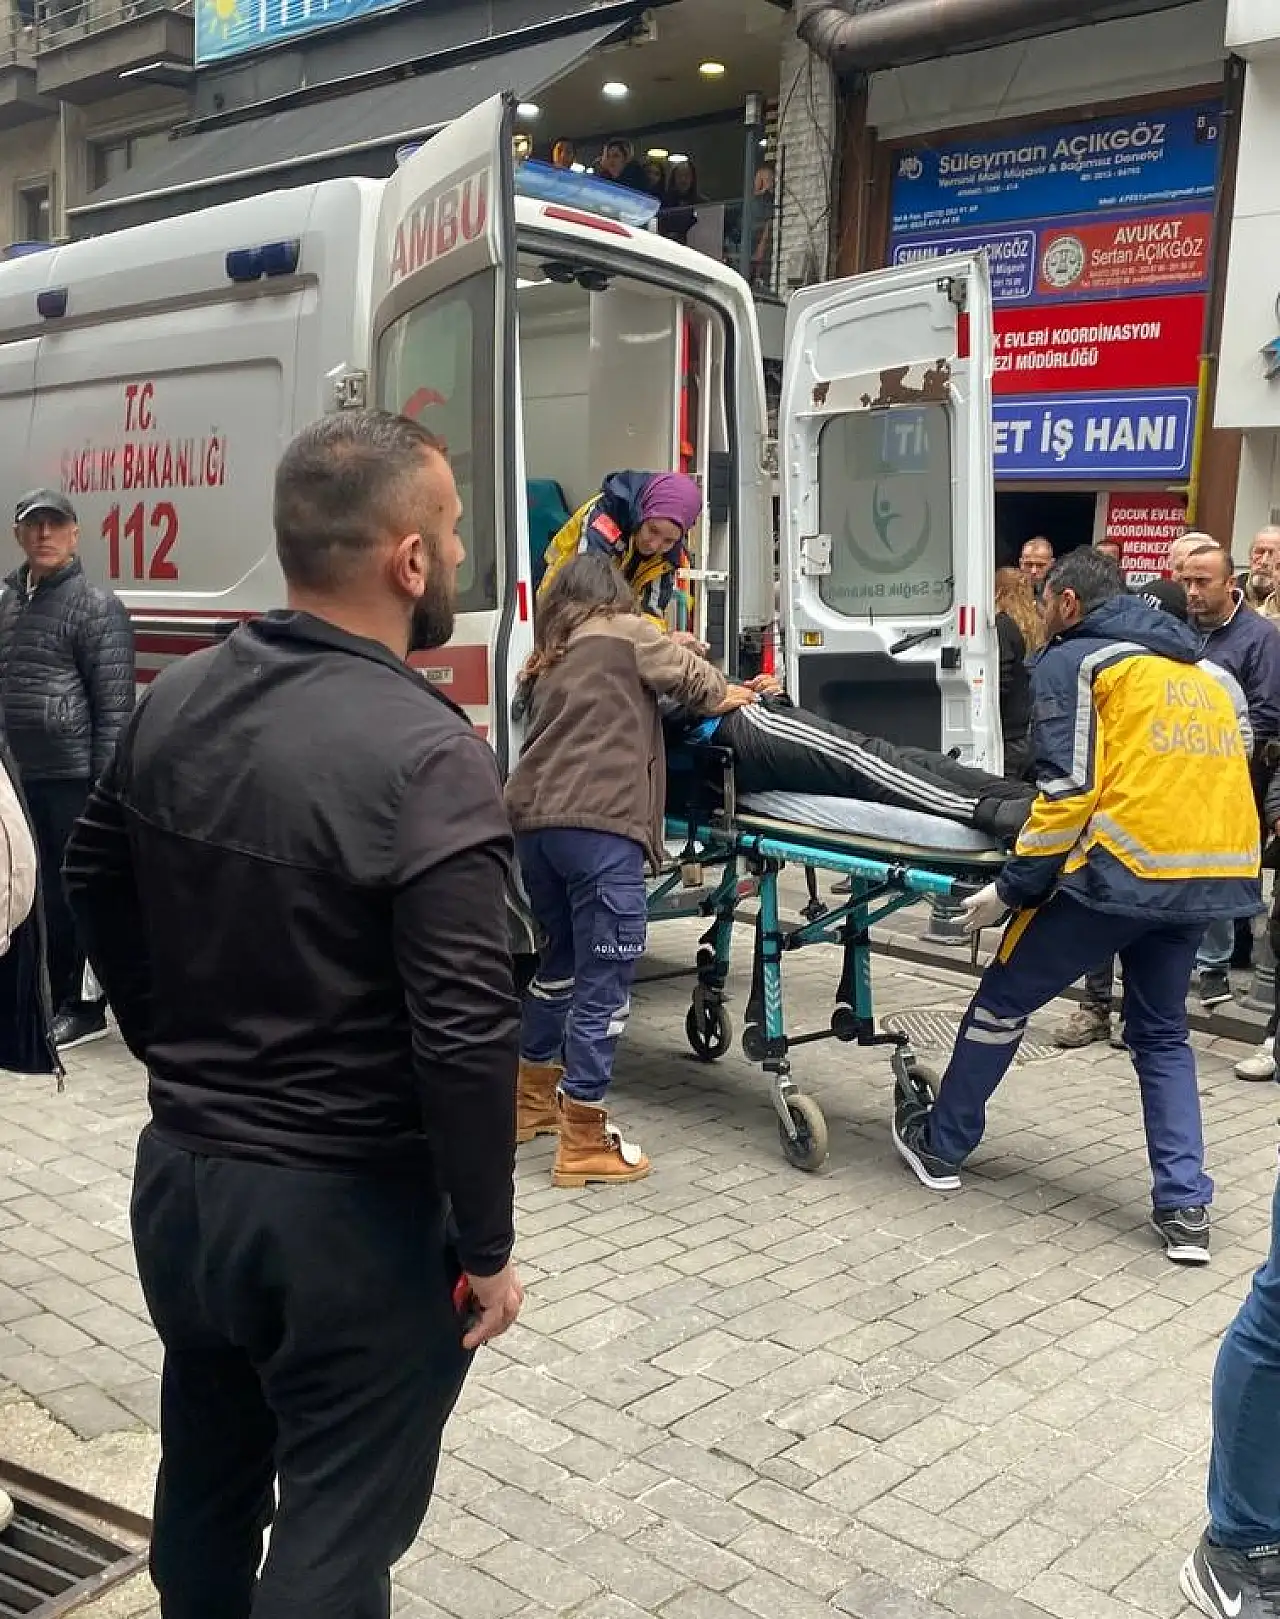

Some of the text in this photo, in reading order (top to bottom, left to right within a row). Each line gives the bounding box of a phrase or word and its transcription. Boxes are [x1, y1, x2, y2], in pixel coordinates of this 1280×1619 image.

[938, 144, 1048, 175] Süleyman
[1052, 121, 1167, 163] AÇIKGÖZ
[1113, 220, 1183, 245] AVUKAT
[1135, 236, 1204, 265] AÇIKGÖZ
[1004, 326, 1050, 349] EVLERİ
[1052, 321, 1161, 346] KOORDİNASYON
[993, 347, 1099, 371] EZİ MÜDÜRLÜĞÜ
[990, 411, 1177, 462] ET İŞ HANI
[122, 424, 226, 490] BAKANLIĞI
[1111, 507, 1186, 522] ÇOCUK EVLER
[101, 501, 179, 581] 112
[1106, 522, 1185, 537] KOORDİNASYO
